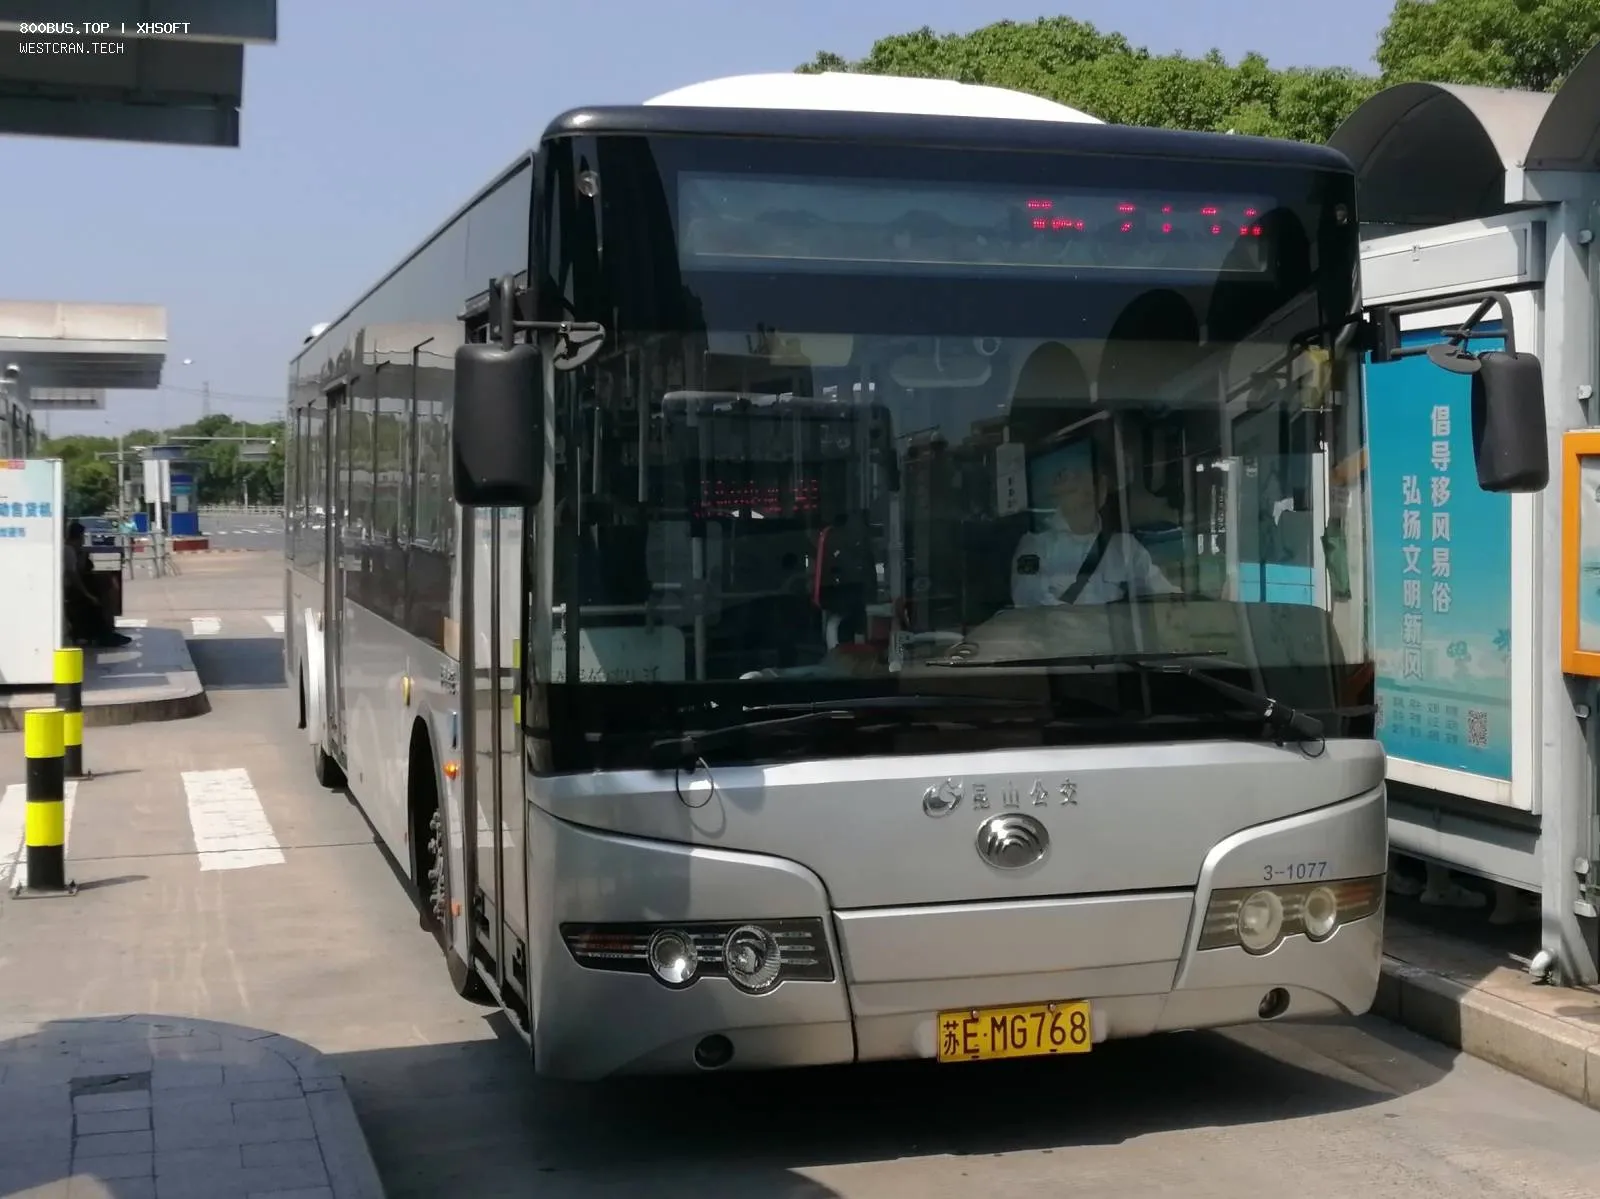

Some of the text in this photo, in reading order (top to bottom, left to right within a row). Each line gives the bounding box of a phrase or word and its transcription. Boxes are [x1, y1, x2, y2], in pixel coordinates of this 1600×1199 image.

[1430, 404, 1451, 614] 倡导移风易俗
[1402, 475, 1422, 679] 弘扬文明新风
[972, 777, 1078, 811] 昆山公交
[1263, 861, 1327, 881] 3-1077
